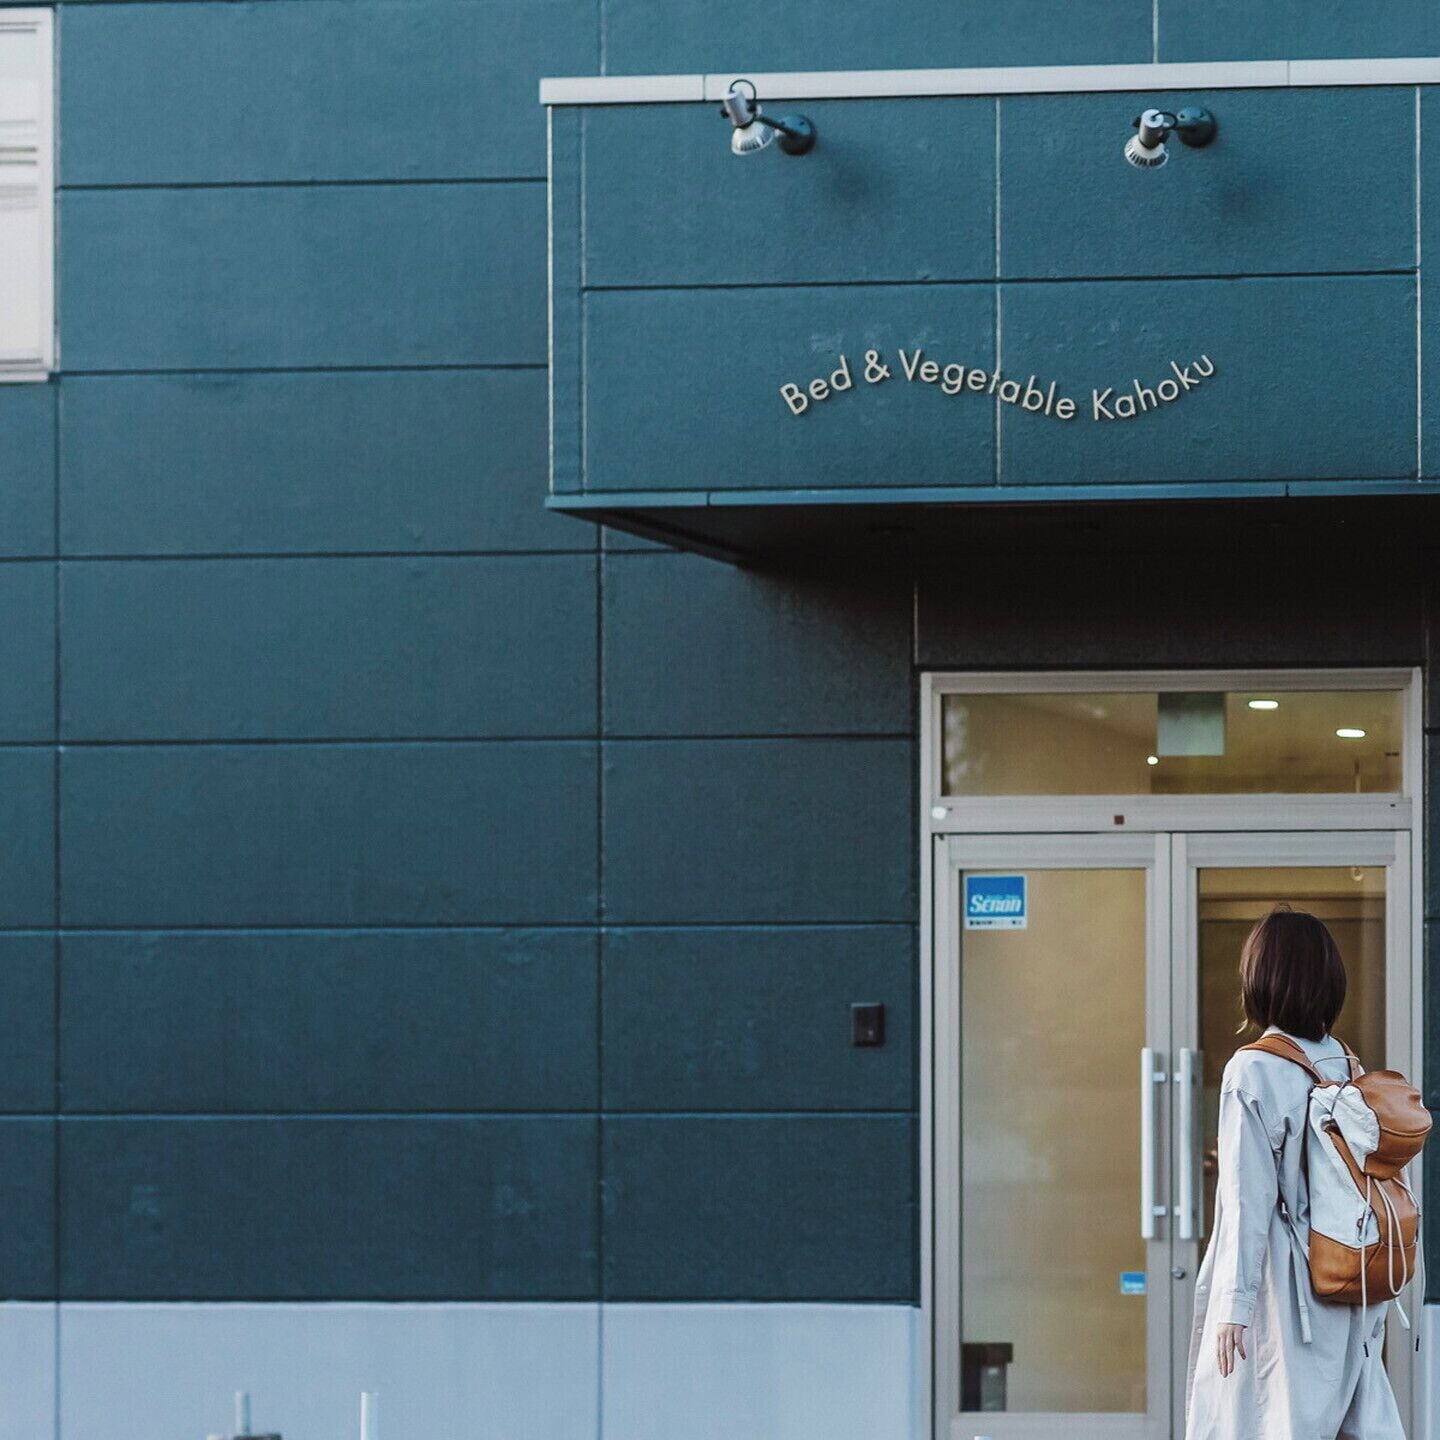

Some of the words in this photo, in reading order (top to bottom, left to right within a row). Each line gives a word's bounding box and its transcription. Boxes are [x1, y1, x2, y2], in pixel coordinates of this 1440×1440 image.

[780, 354, 852, 415] Bed
[864, 349, 891, 384] &
[899, 349, 1076, 420] Vegetable
[1092, 354, 1215, 421] Kahoku
